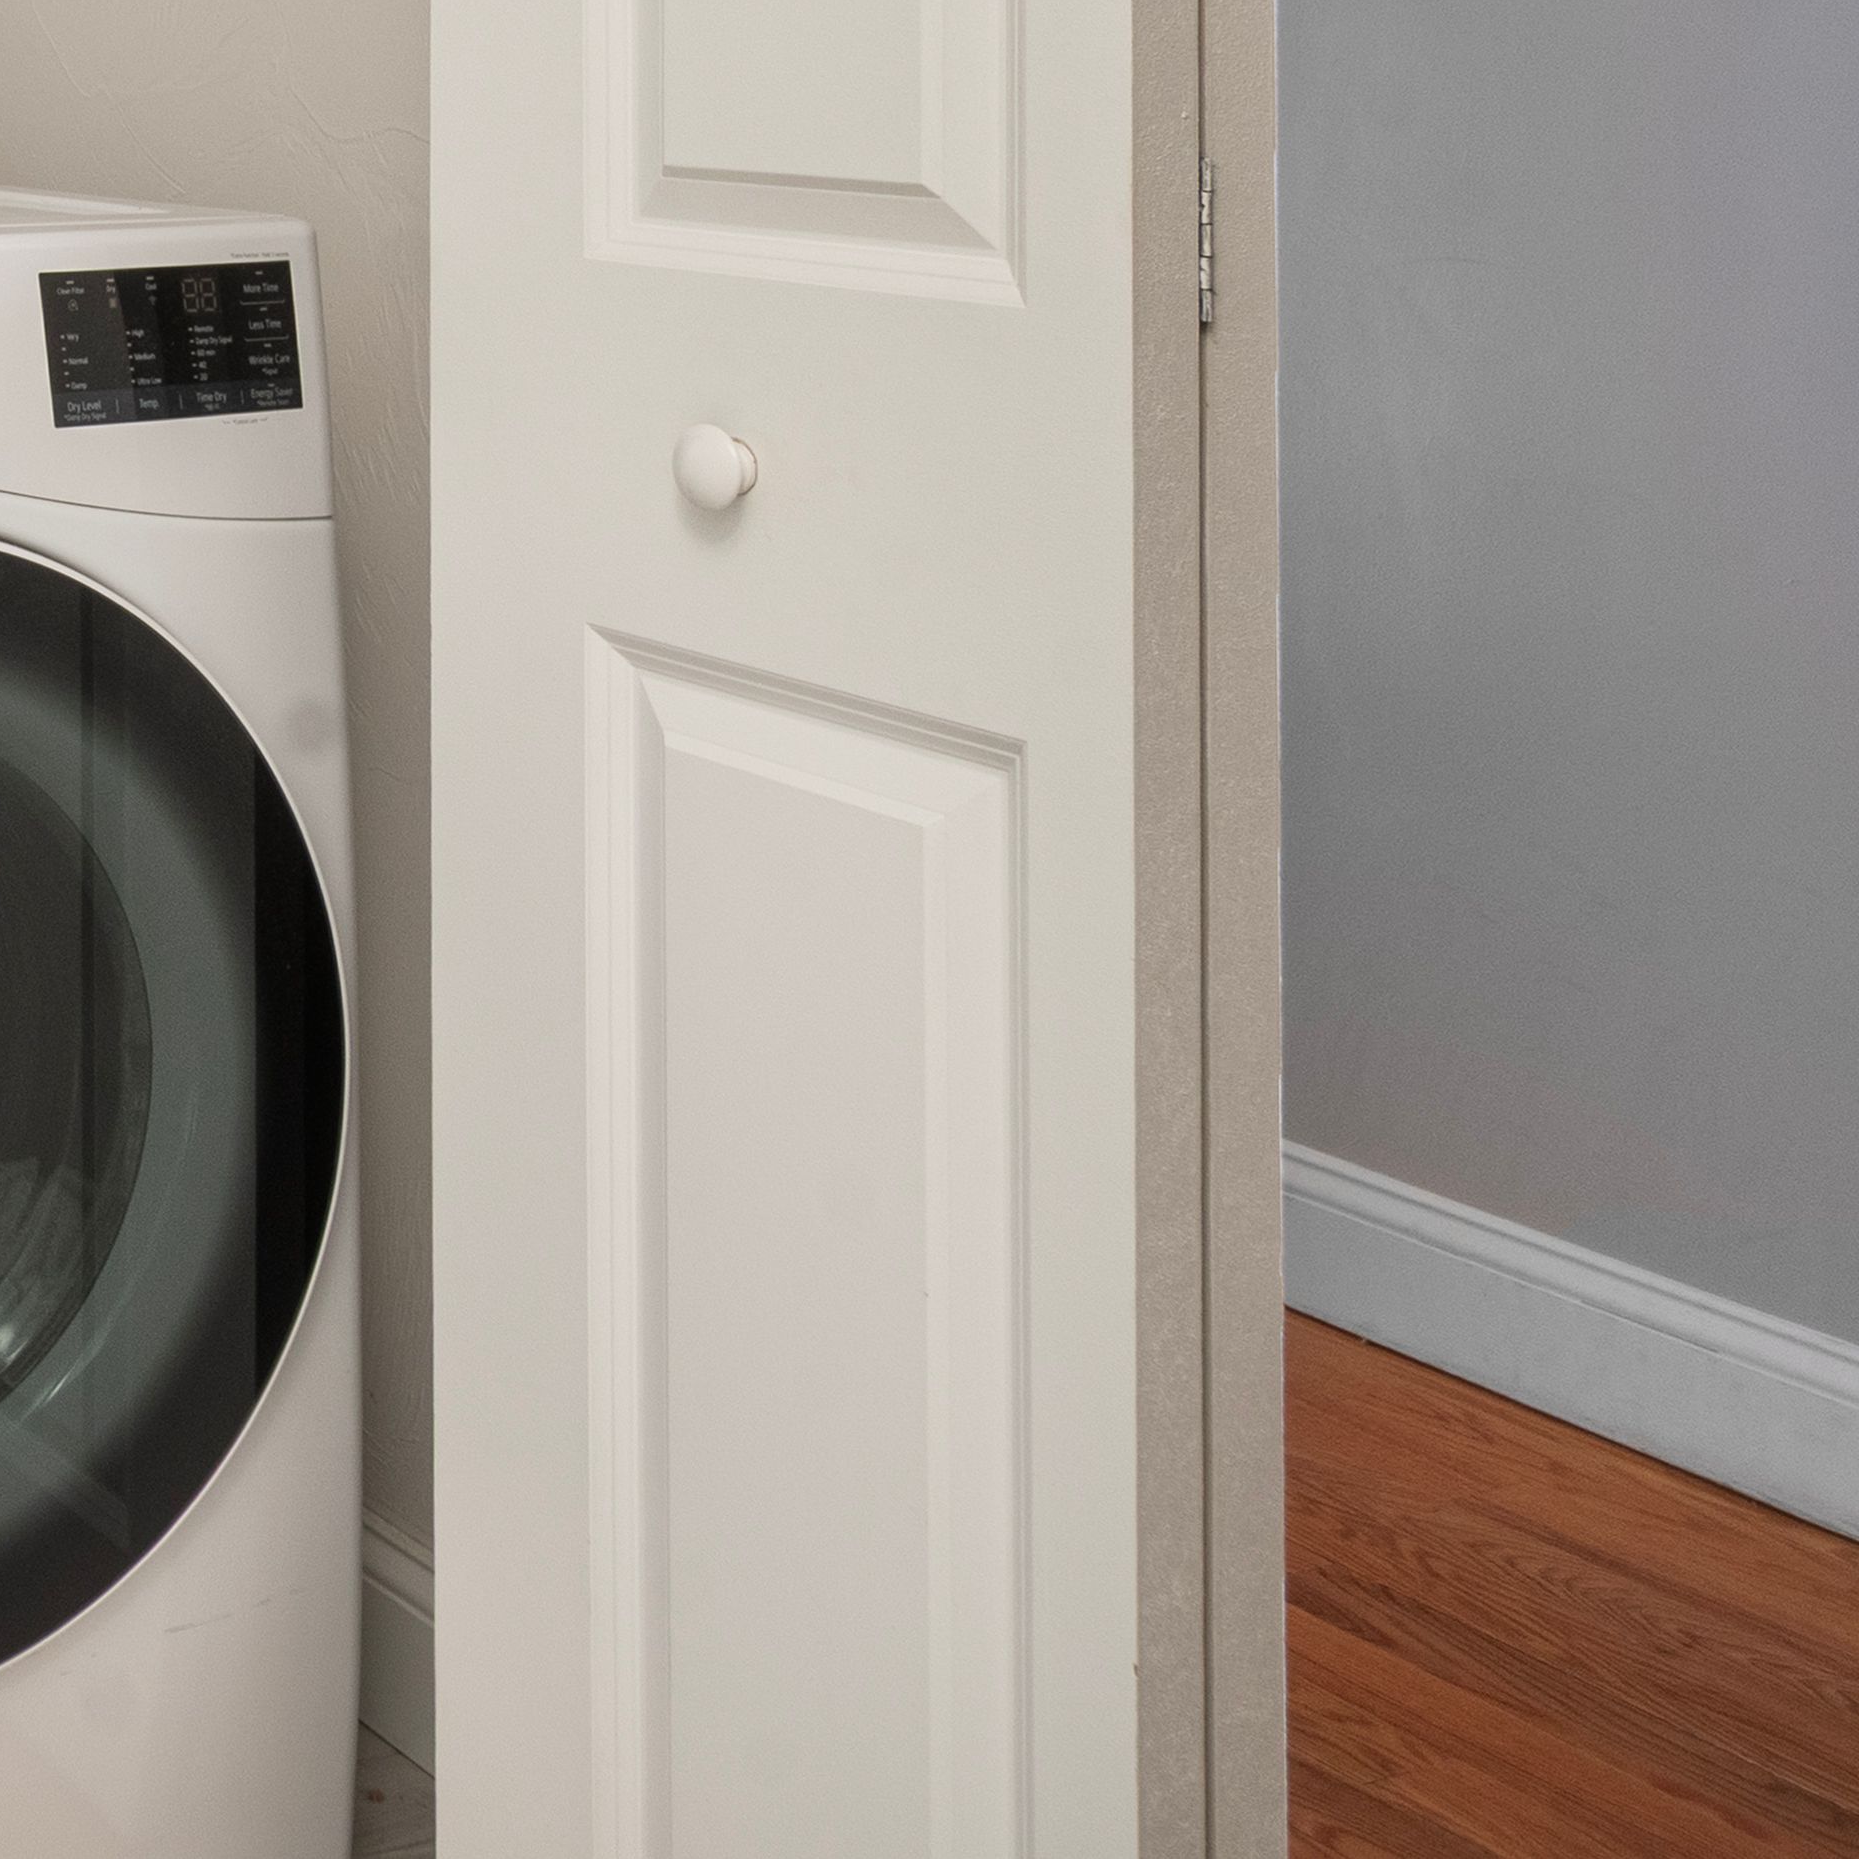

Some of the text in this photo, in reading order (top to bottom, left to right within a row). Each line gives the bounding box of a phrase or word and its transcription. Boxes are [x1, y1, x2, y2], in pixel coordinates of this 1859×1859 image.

[263, 282, 279, 292] Time
[249, 318, 282, 330] Less Time
[214, 391, 227, 404] Dry
[67, 400, 102, 413] Dry Level
